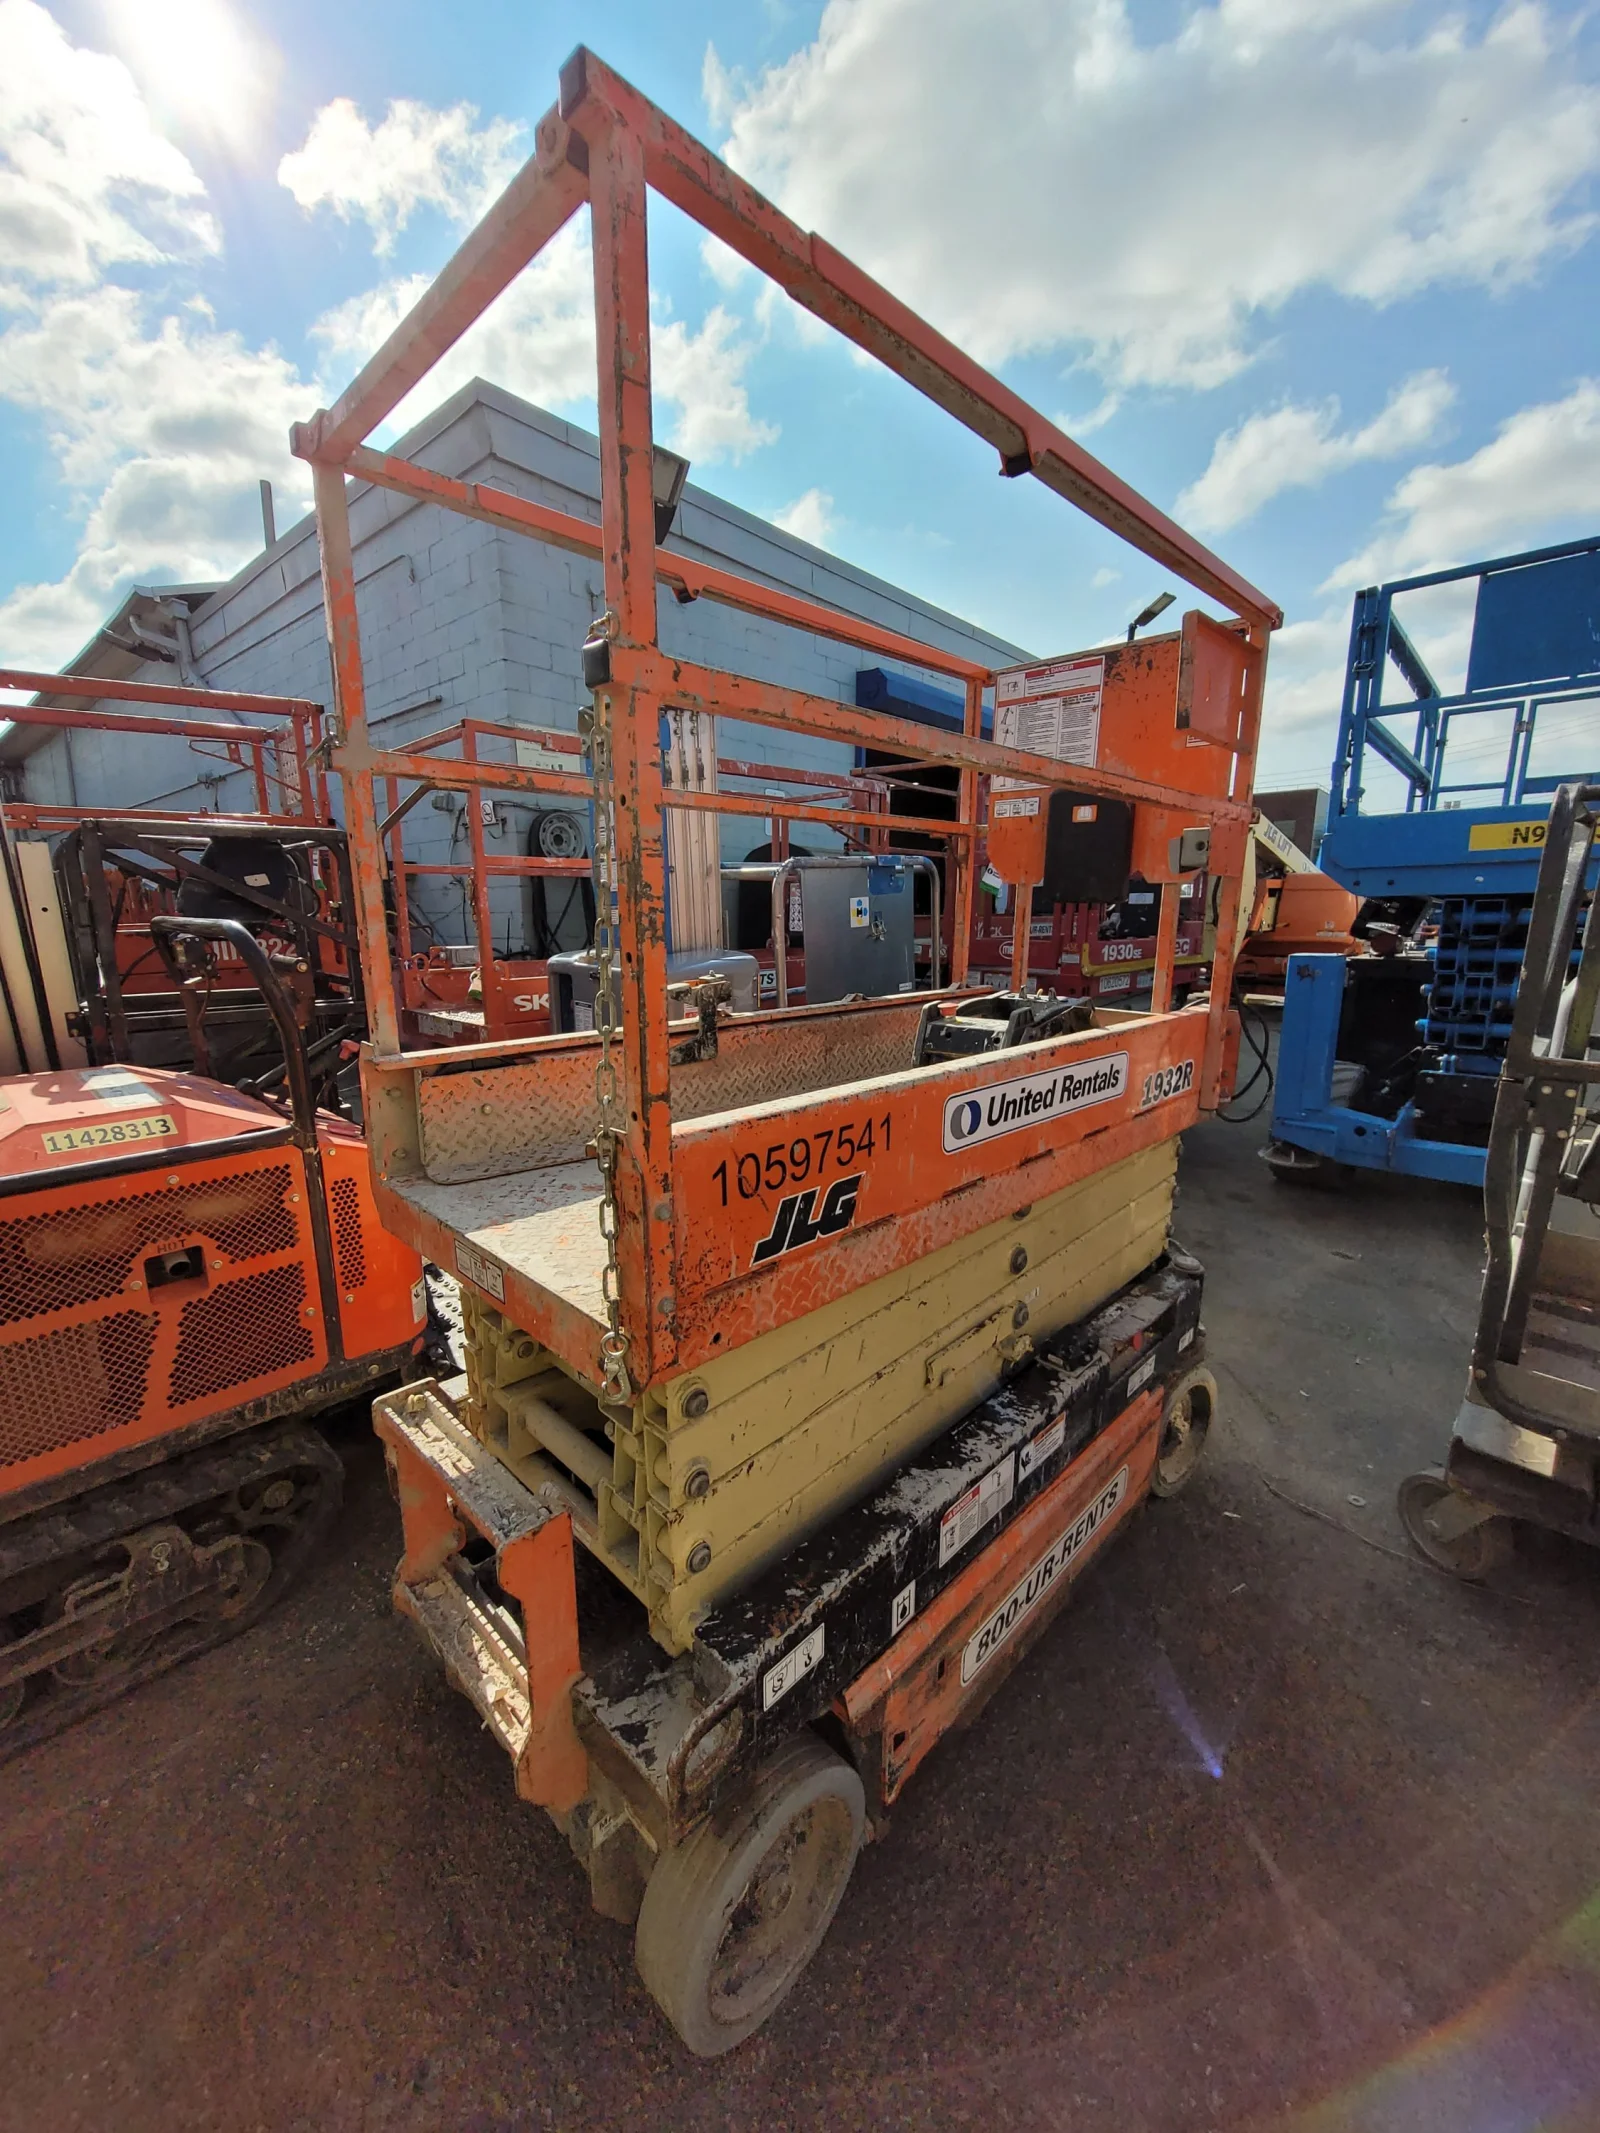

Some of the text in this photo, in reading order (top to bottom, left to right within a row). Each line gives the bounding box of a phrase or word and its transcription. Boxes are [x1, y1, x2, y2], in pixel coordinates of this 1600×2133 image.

[513, 993, 549, 1012] SK
[760, 973, 775, 985] TS
[987, 1063, 1120, 1127] United Rentals
[1141, 1060, 1194, 1107] 1932R
[47, 1118, 171, 1152] 11428313
[712, 1112, 891, 1207] 10597541
[750, 1171, 867, 1267] JLG
[157, 1238, 187, 1254] HOT
[975, 1481, 1119, 1663] 800-UR-RENTS
